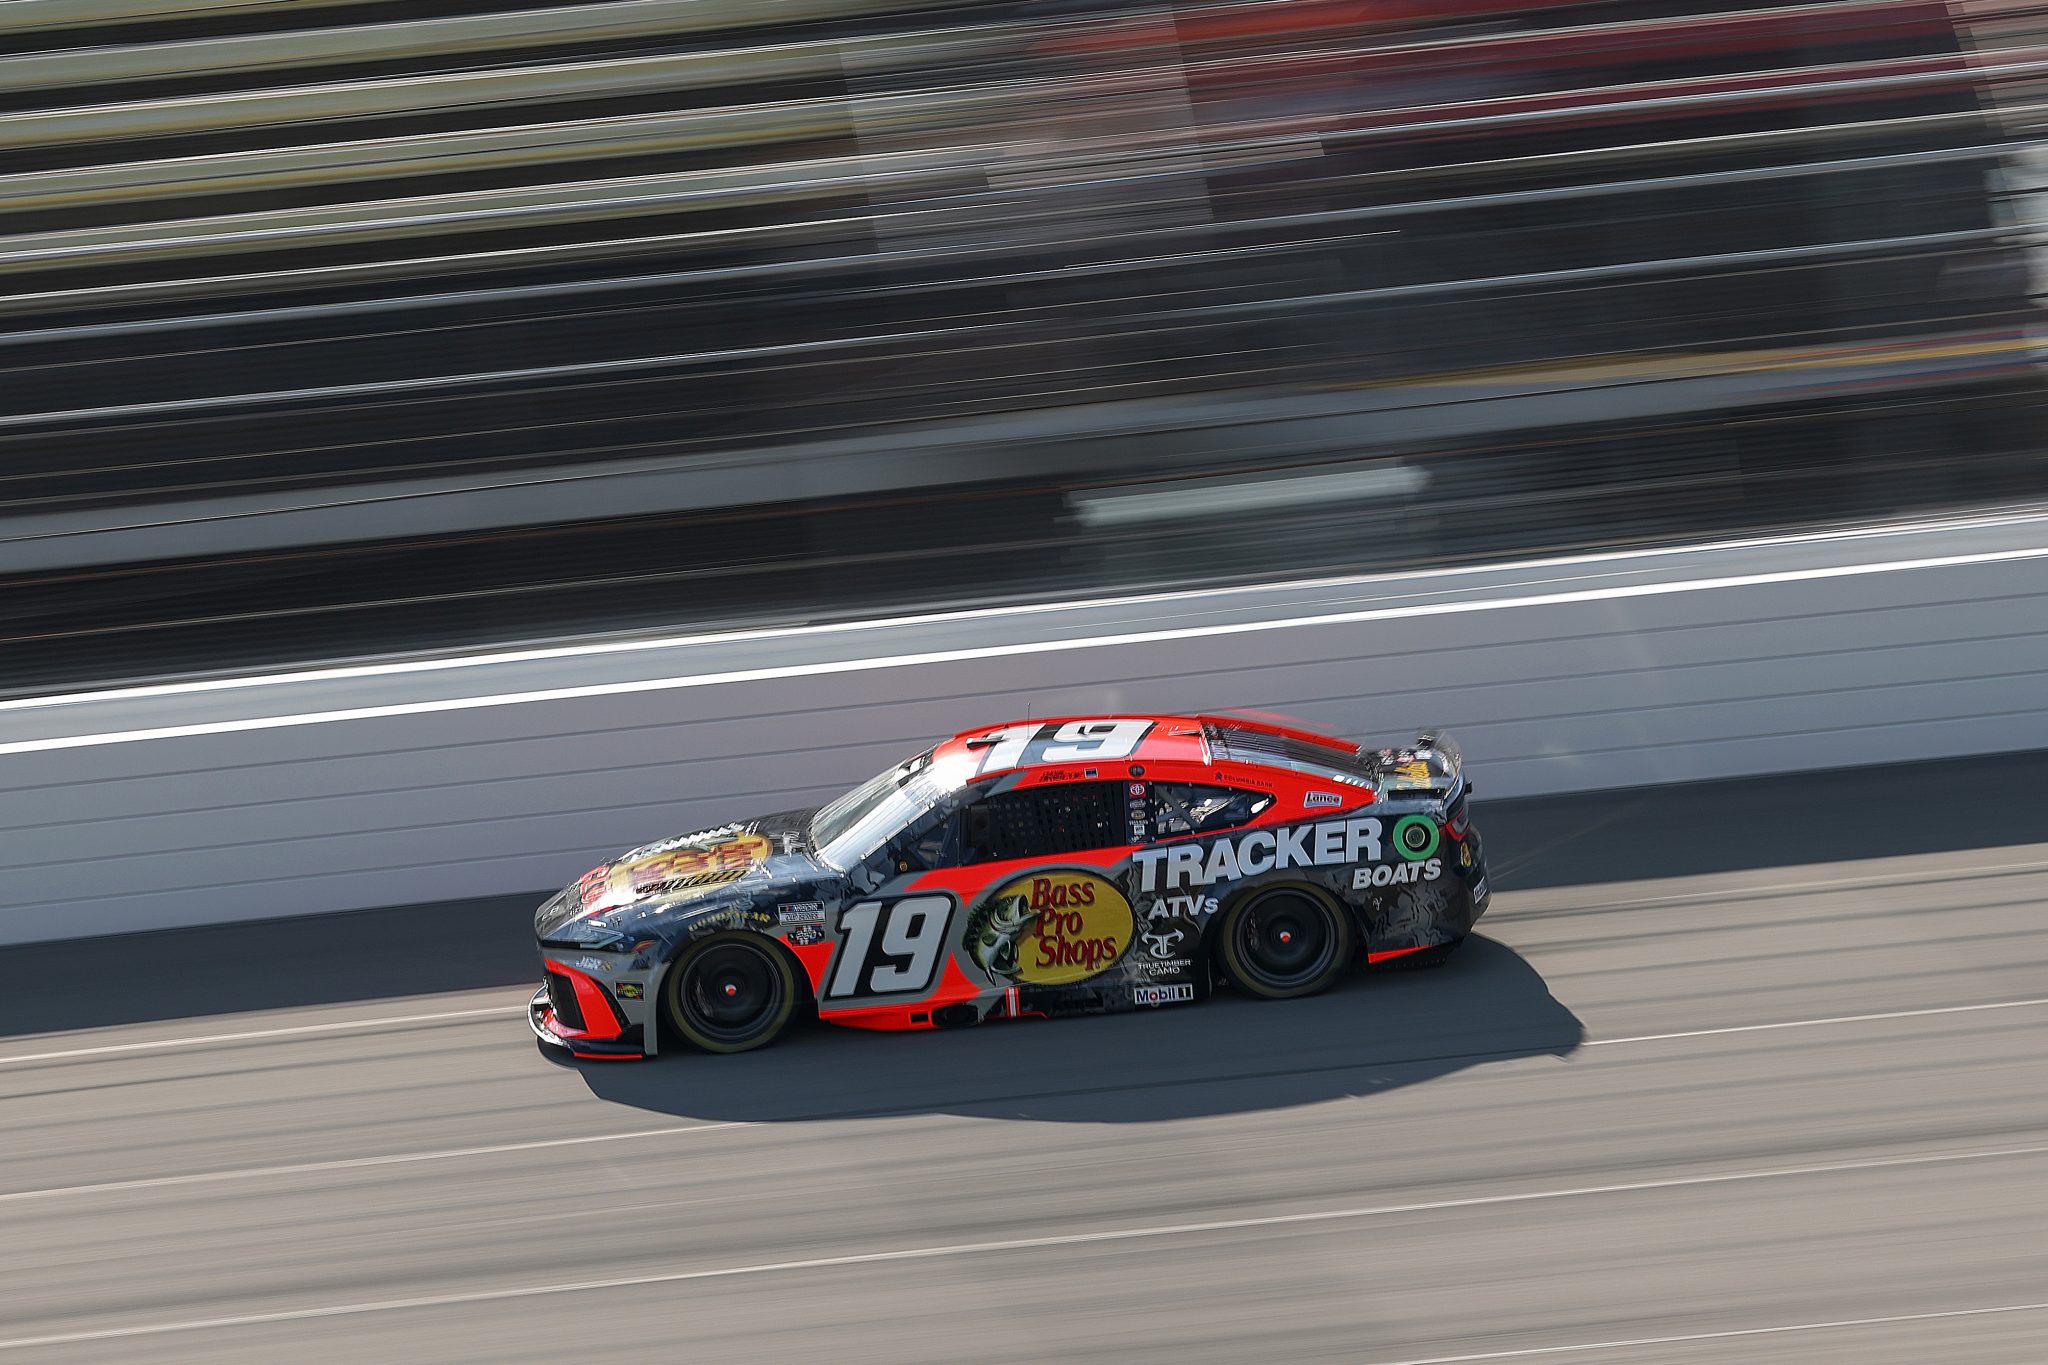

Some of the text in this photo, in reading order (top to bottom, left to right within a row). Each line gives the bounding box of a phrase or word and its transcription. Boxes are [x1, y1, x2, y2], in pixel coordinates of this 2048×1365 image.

[981, 720, 1154, 772] 19
[1133, 817, 1383, 892] TRACKER
[1352, 858, 1442, 890] BOATS
[1030, 878, 1095, 909] Bass
[1148, 895, 1219, 920] ATVs
[1033, 908, 1083, 938] Pro
[829, 896, 952, 997] 19
[1036, 935, 1117, 971] Shops
[1136, 986, 1175, 1002] Mobil
